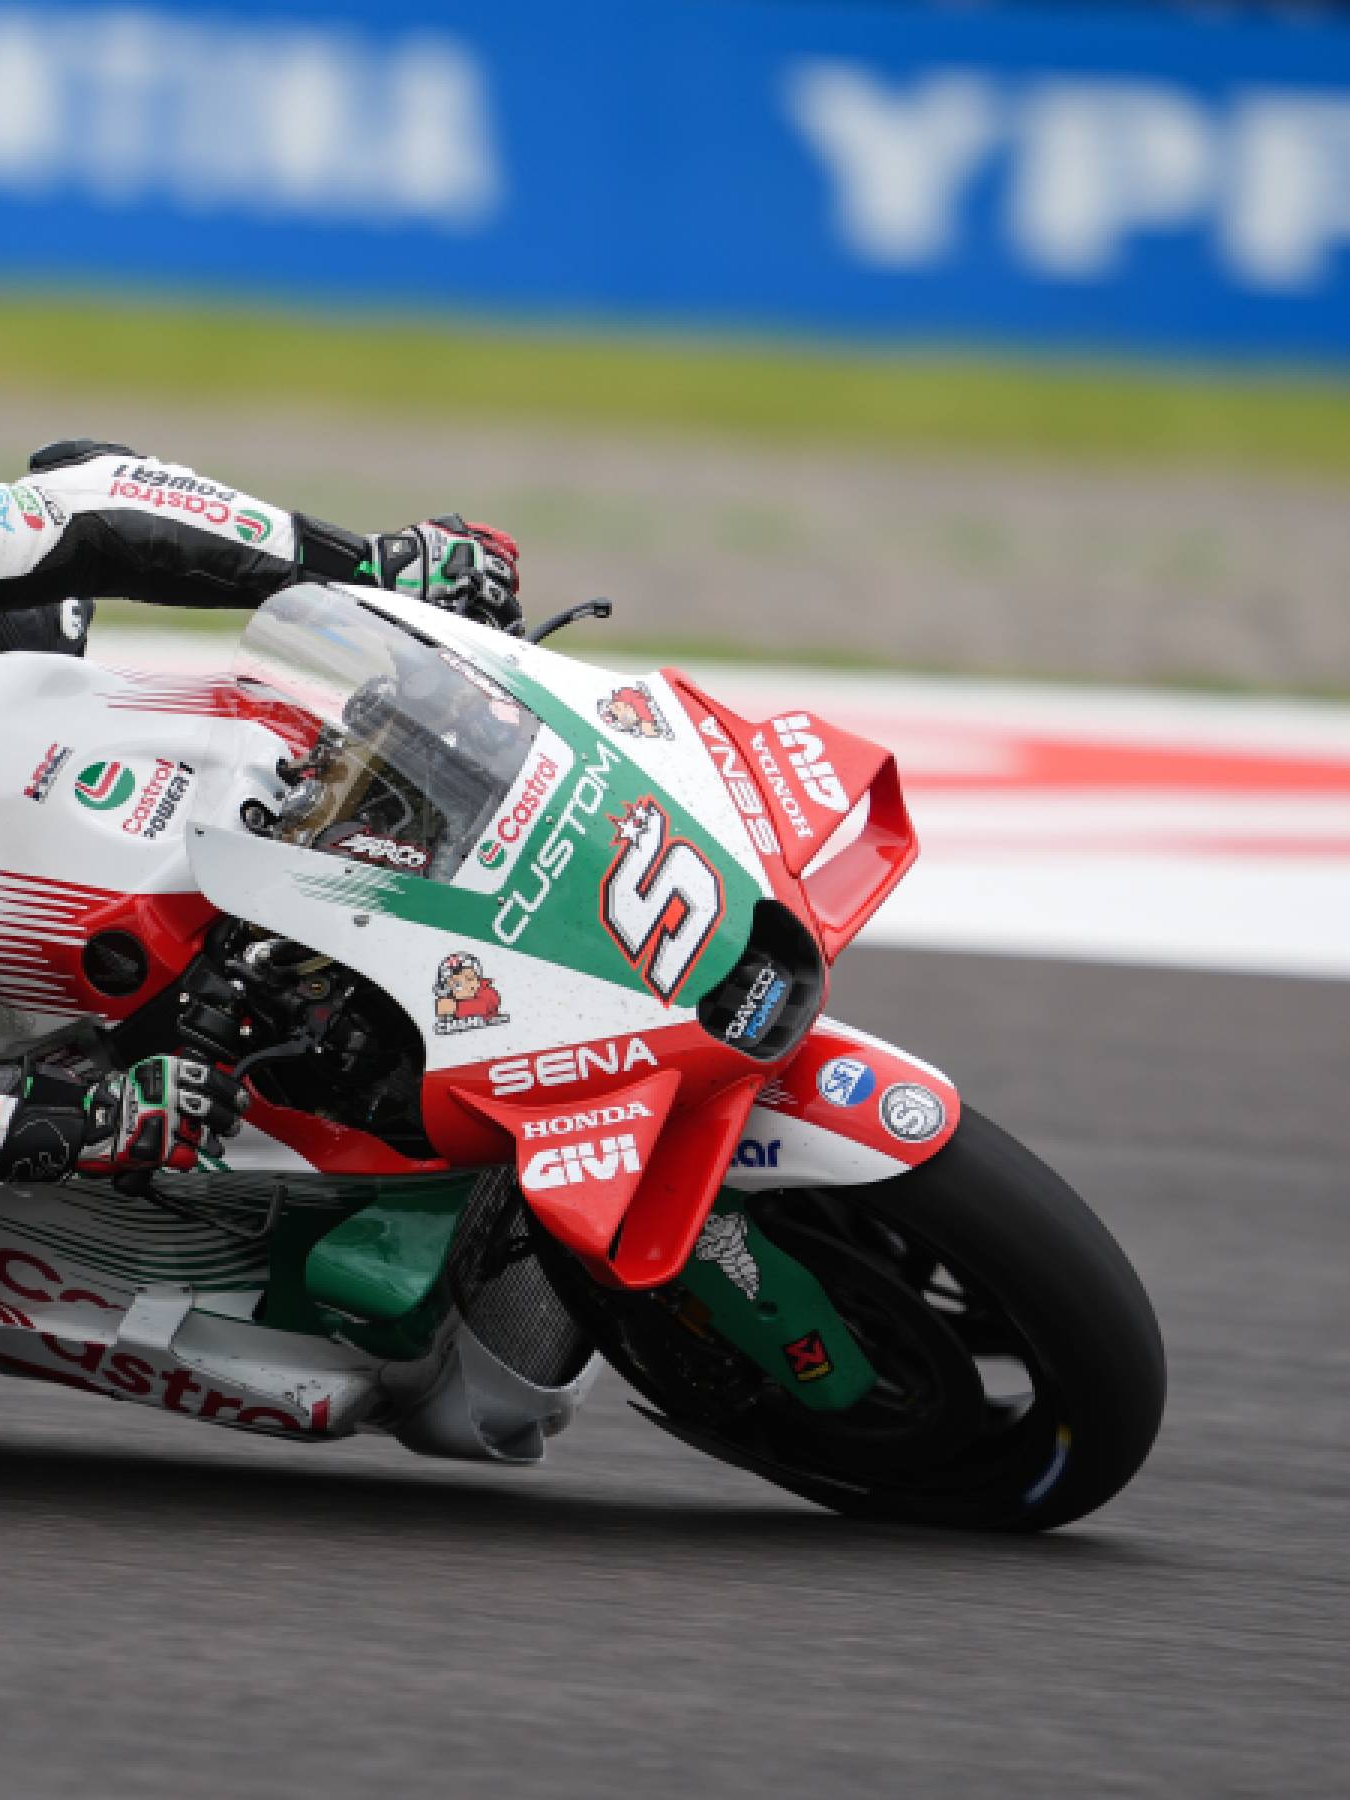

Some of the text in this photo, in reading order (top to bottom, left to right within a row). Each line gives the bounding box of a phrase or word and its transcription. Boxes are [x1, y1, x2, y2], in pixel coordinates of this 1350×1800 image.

[110, 480, 231, 523] Castrol
[122, 757, 176, 835] Castrol
[497, 753, 558, 843] Castrol
[700, 715, 782, 855] SENA
[750, 731, 814, 839] HONDA
[771, 712, 849, 812] GIVI
[492, 740, 621, 944] CUSTOM
[725, 964, 778, 1044] DAYCO
[488, 1037, 658, 1097] SENA
[521, 1101, 655, 1140] HONDA
[521, 1133, 642, 1192] GIVI
